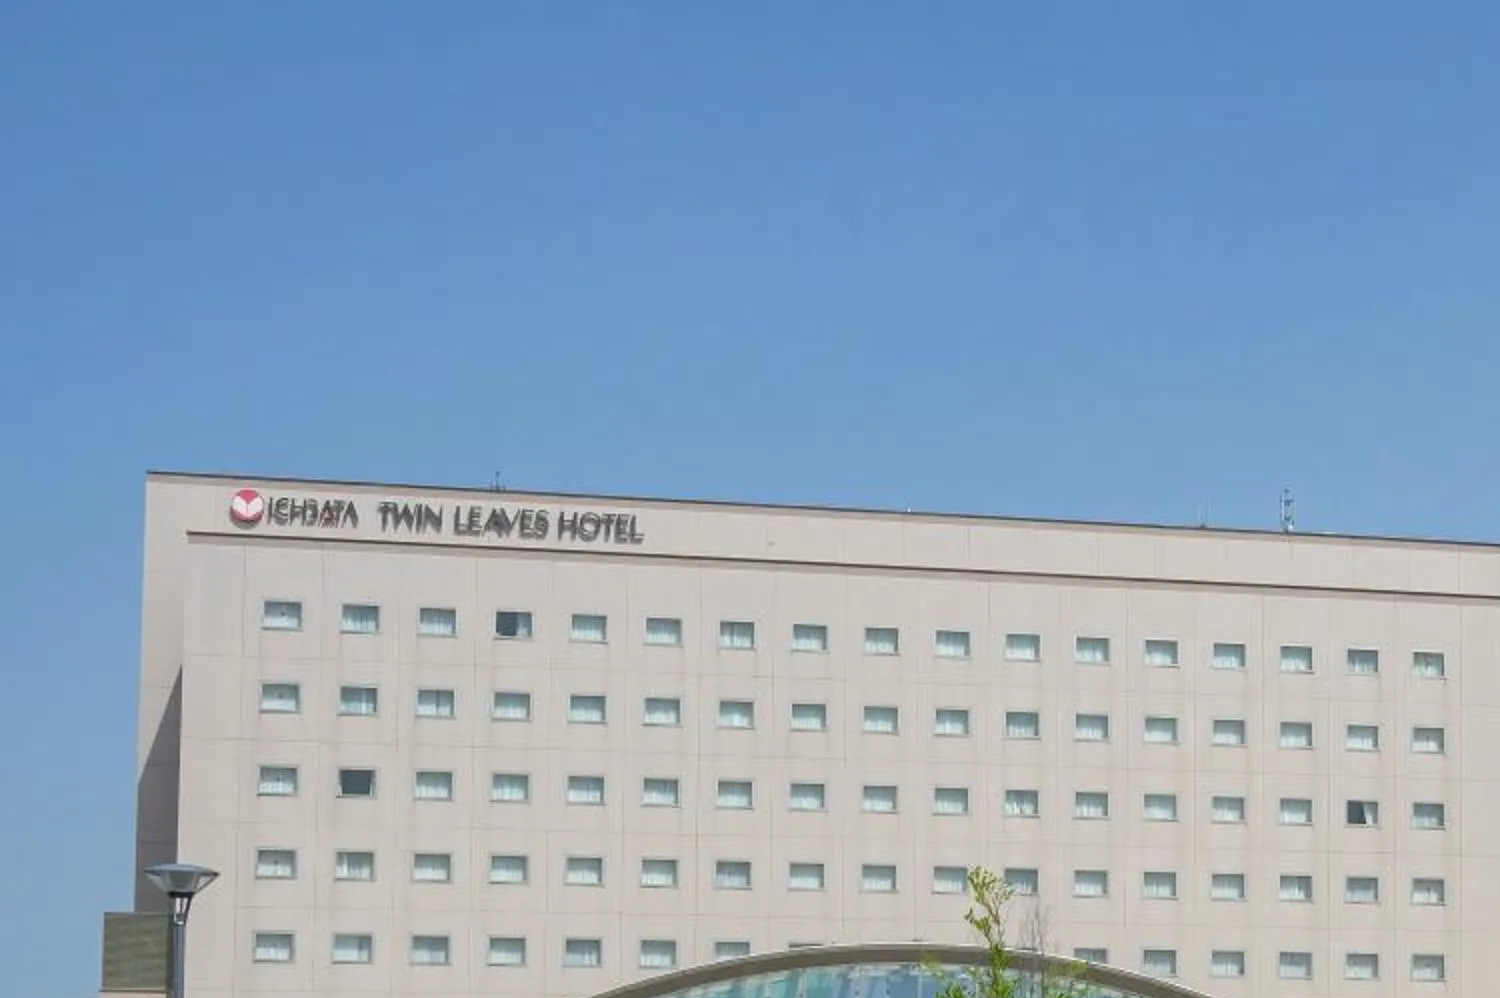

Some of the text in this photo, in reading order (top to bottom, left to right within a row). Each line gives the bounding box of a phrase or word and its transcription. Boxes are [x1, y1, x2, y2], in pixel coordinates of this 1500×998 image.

[267, 496, 646, 545] ICHIBATA TWIN LEAVES HOTEL
